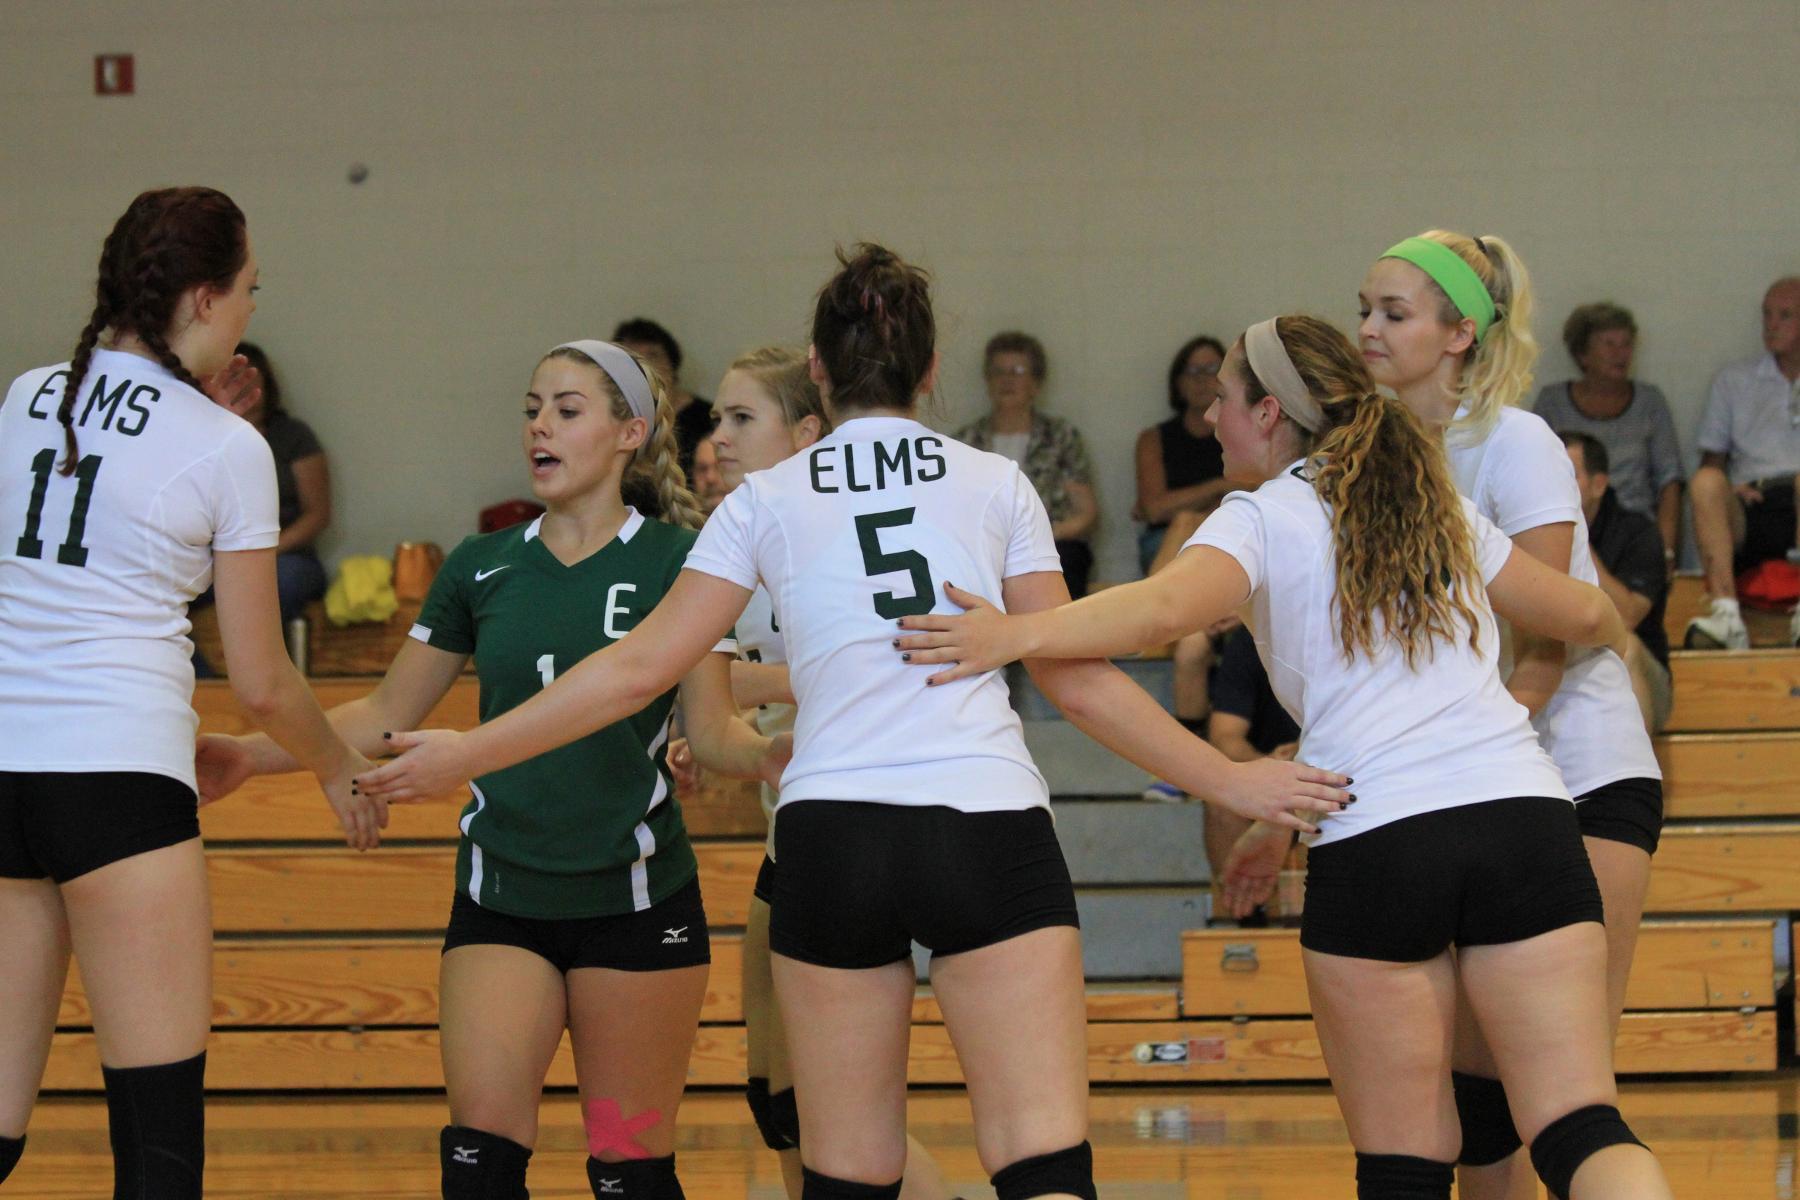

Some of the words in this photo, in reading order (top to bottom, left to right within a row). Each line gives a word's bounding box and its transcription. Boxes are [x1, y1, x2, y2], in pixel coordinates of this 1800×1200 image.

[809, 436, 947, 493] ELMS
[16, 448, 103, 567] 11
[854, 506, 936, 620] 5
[603, 583, 637, 639] E
